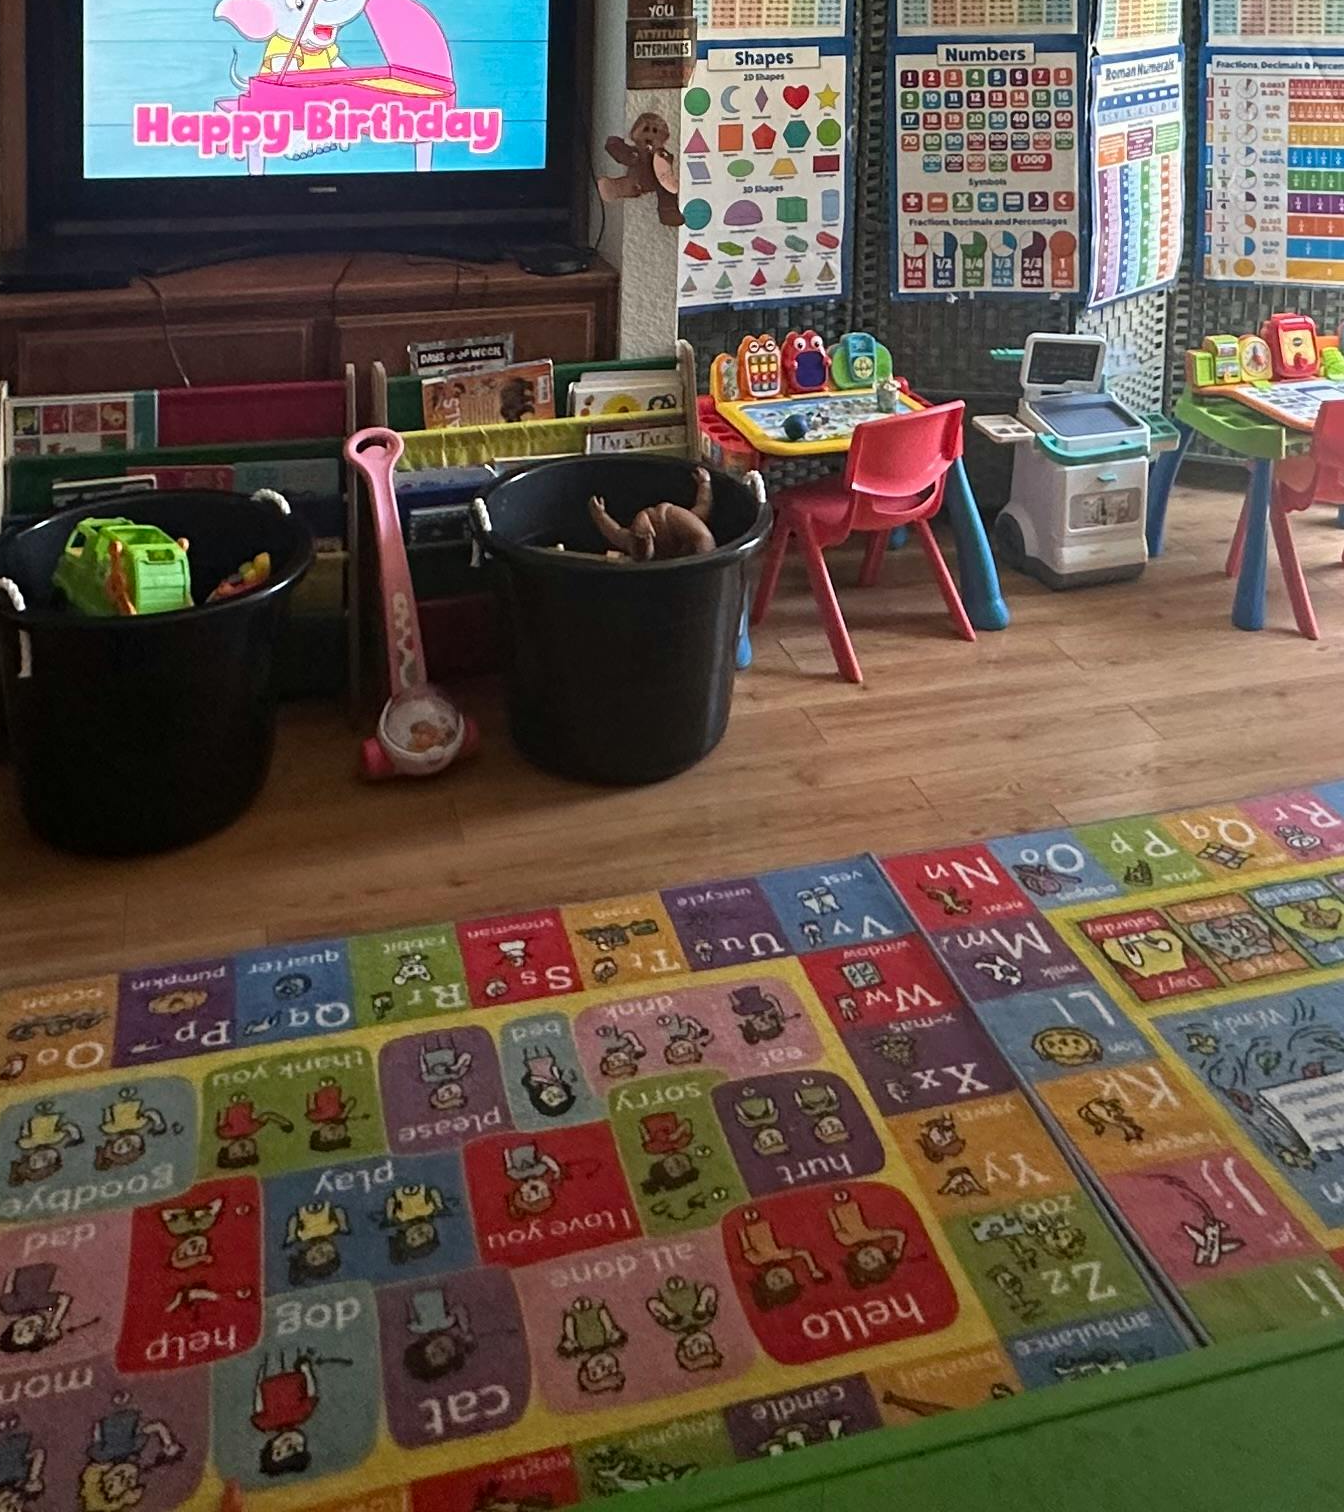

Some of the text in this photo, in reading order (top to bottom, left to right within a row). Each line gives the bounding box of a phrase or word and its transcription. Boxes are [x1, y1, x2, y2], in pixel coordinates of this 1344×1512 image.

[648, 4, 674, 17] YOU
[635, 28, 689, 38] ATTITUDE
[634, 40, 689, 57] DETERMINES
[734, 50, 794, 69] Shapes
[944, 46, 1026, 63] Numbers
[1104, 59, 1175, 81] Roman Numerals
[1216, 61, 1260, 70] Fractions,
[1261, 60, 1303, 70] Decimals
[743, 72, 784, 82] 2D Shapes
[134, 99, 503, 160] Happy Birthday
[742, 184, 783, 195] 3D Shapes
[968, 177, 1007, 188] Symbols
[909, 218, 950, 227] Fractions,
[1013, 218, 1067, 227] Percentages
[420, 344, 502, 364] DAYS WEEK
[638, 431, 674, 448] TALK
[819, 869, 863, 887] vest
[675, 887, 753, 909] unicycle
[467, 916, 554, 940] snowman
[1084, 915, 1160, 935] Saturday
[382, 934, 448, 955] rabbit
[842, 942, 912, 961] window
[247, 951, 340, 976] quarter
[131, 965, 227, 992] pumpkin
[1171, 976, 1202, 992] Day
[600, 997, 674, 1019] drink
[887, 1012, 957, 1034] x-mas
[1212, 1009, 1287, 1033] Windy
[510, 1022, 562, 1044] bed
[210, 1042, 364, 1086] thank you
[754, 1045, 805, 1066] eat
[614, 1080, 702, 1113] sorry
[396, 1112, 503, 1146] please
[315, 1162, 395, 1197] play
[776, 1152, 854, 1185] hurt
[1018, 1196, 1078, 1220] zoo
[22, 1221, 95, 1256] dad
[487, 1211, 632, 1253] I love you
[548, 1244, 694, 1290] all done
[276, 1302, 362, 1335] dog
[799, 1290, 923, 1343] hello
[144, 1325, 237, 1363] help
[1013, 1313, 1153, 1358] ambulance
[422, 1386, 514, 1437] cat
[750, 1385, 848, 1427] candle
